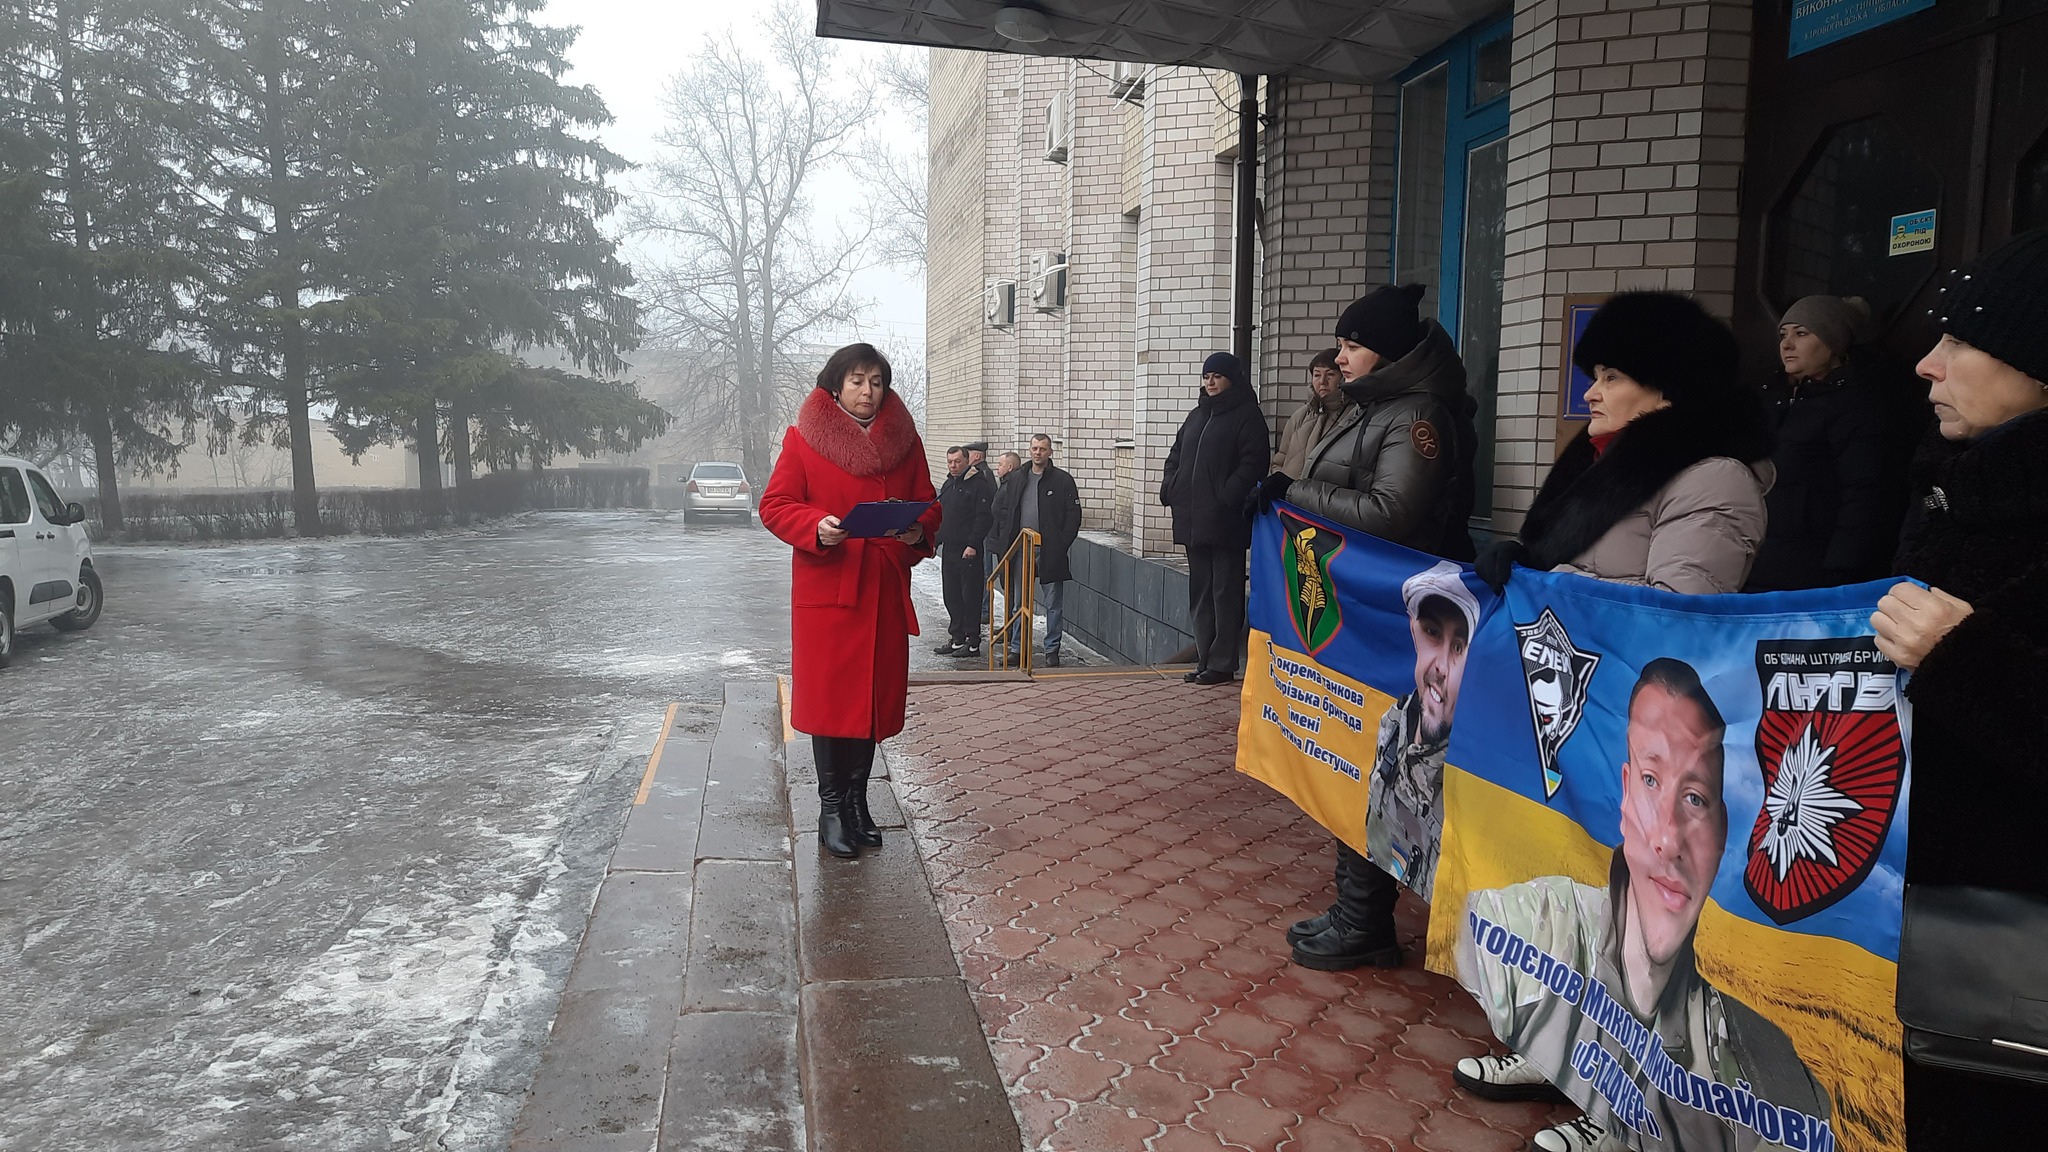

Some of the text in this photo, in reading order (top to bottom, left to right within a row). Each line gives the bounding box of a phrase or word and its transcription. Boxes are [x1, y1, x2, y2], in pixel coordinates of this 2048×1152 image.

[1892, 237, 1932, 250] ОХОРОНОЮ
[1287, 703, 1321, 733] імені
[1304, 737, 1361, 782] Пестушка
[1580, 975, 1650, 1066] Микола
